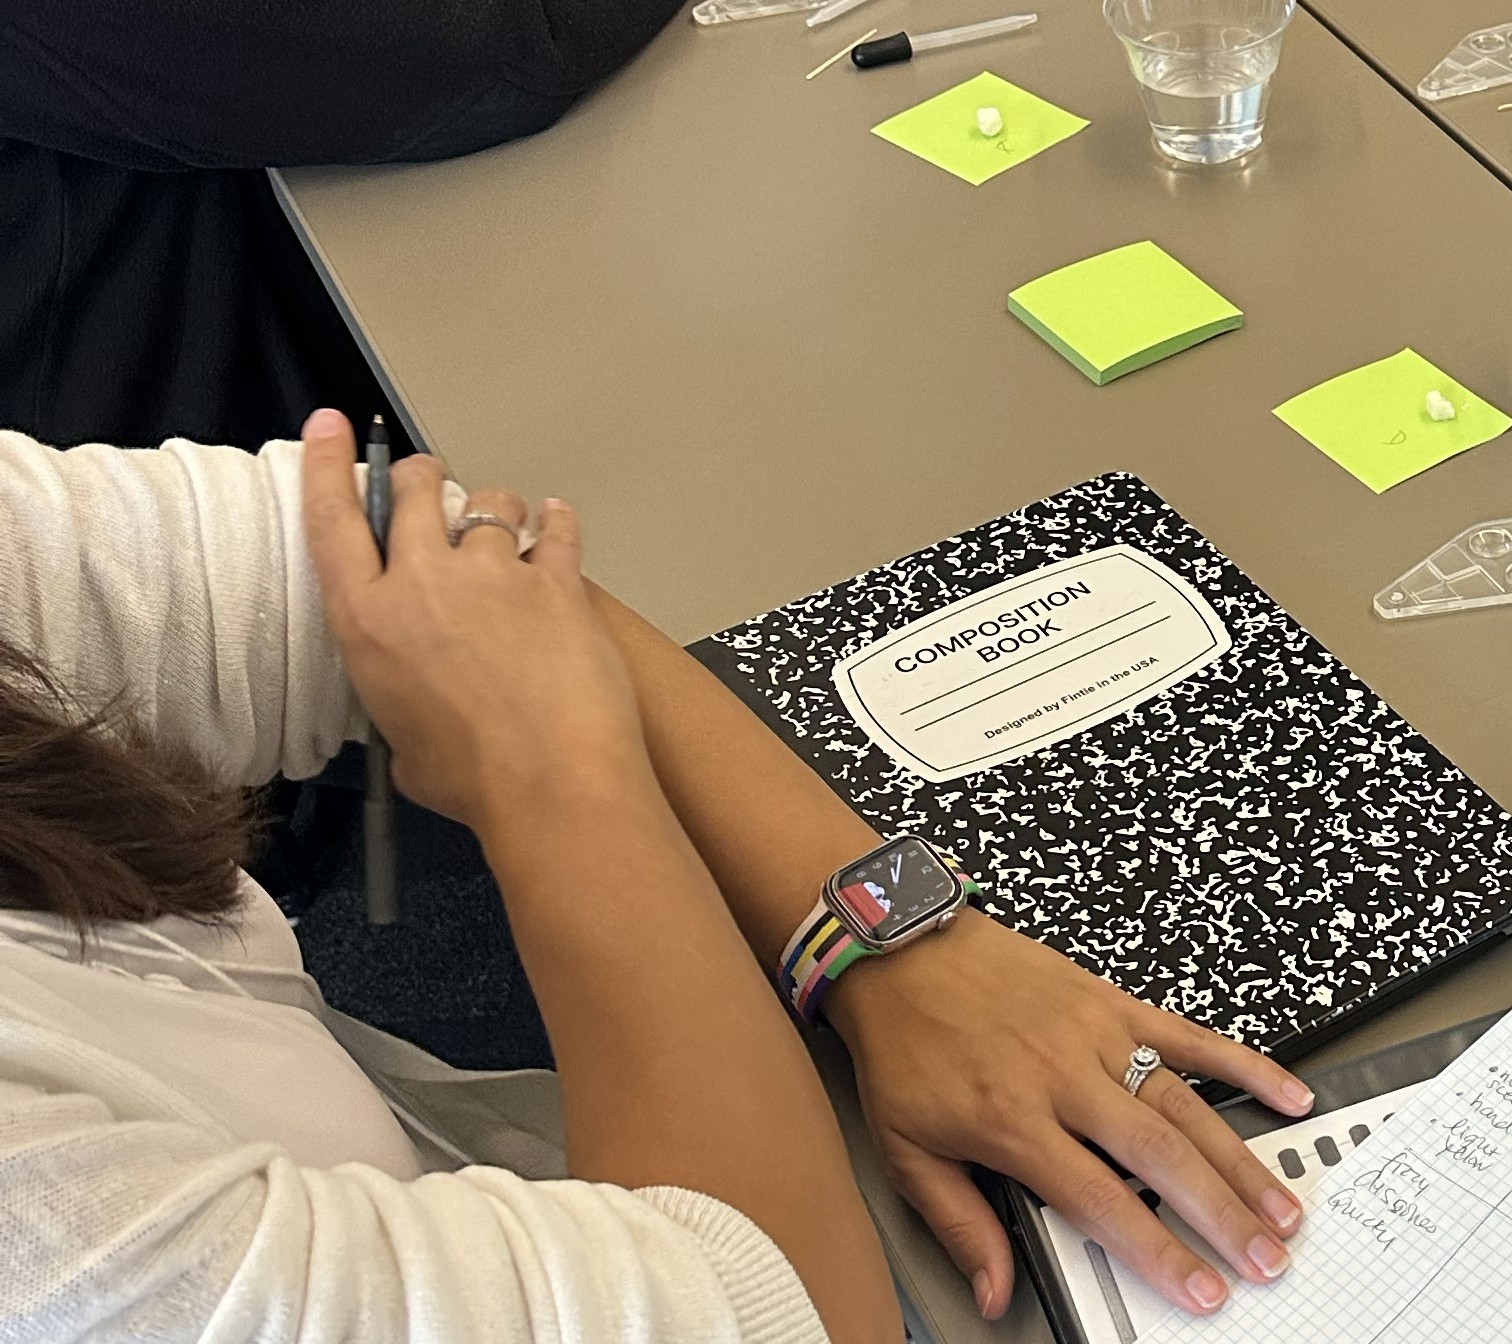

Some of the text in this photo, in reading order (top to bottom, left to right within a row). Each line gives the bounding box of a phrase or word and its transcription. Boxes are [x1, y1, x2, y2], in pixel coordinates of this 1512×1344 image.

[893, 580, 1092, 674] COMPOSITION
[975, 617, 1063, 664] BOOK
[984, 655, 1161, 740] Designed by Fintie in the USA
[1381, 1152, 1431, 1198] fizzy
